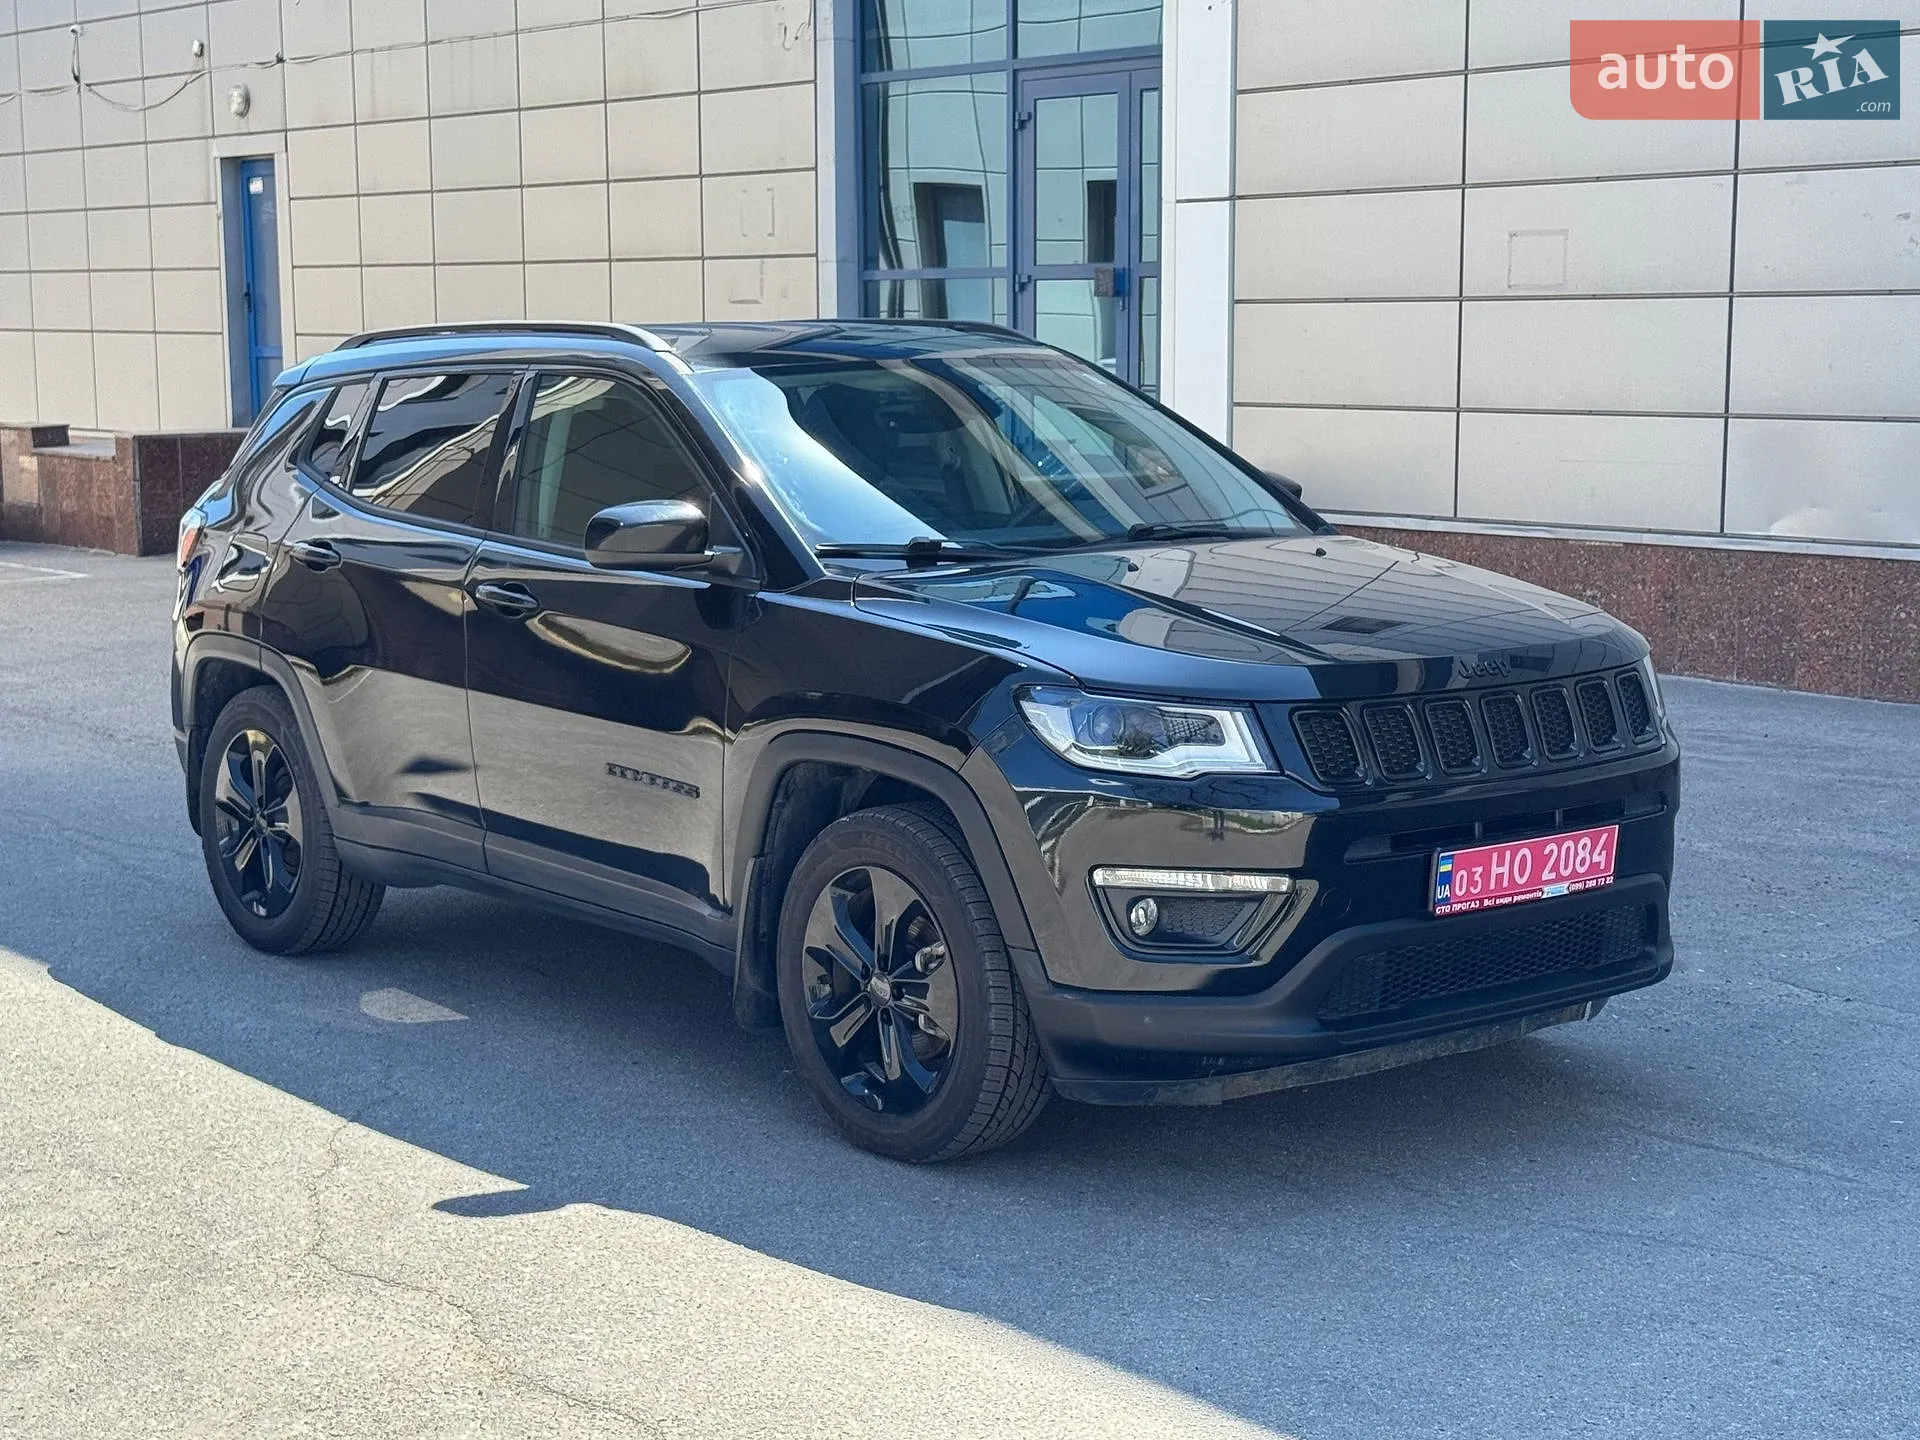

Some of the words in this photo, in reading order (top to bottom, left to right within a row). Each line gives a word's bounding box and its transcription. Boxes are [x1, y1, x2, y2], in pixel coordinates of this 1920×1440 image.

[1458, 659, 1511, 679] Jeep
[1455, 865, 1483, 897] 03
[1489, 847, 1533, 890] HO
[1541, 832, 1609, 881] 2084
[1437, 884, 1451, 899] UA
[1435, 904, 1451, 914] СТО
[1452, 900, 1480, 911] ПРОГАЗ
